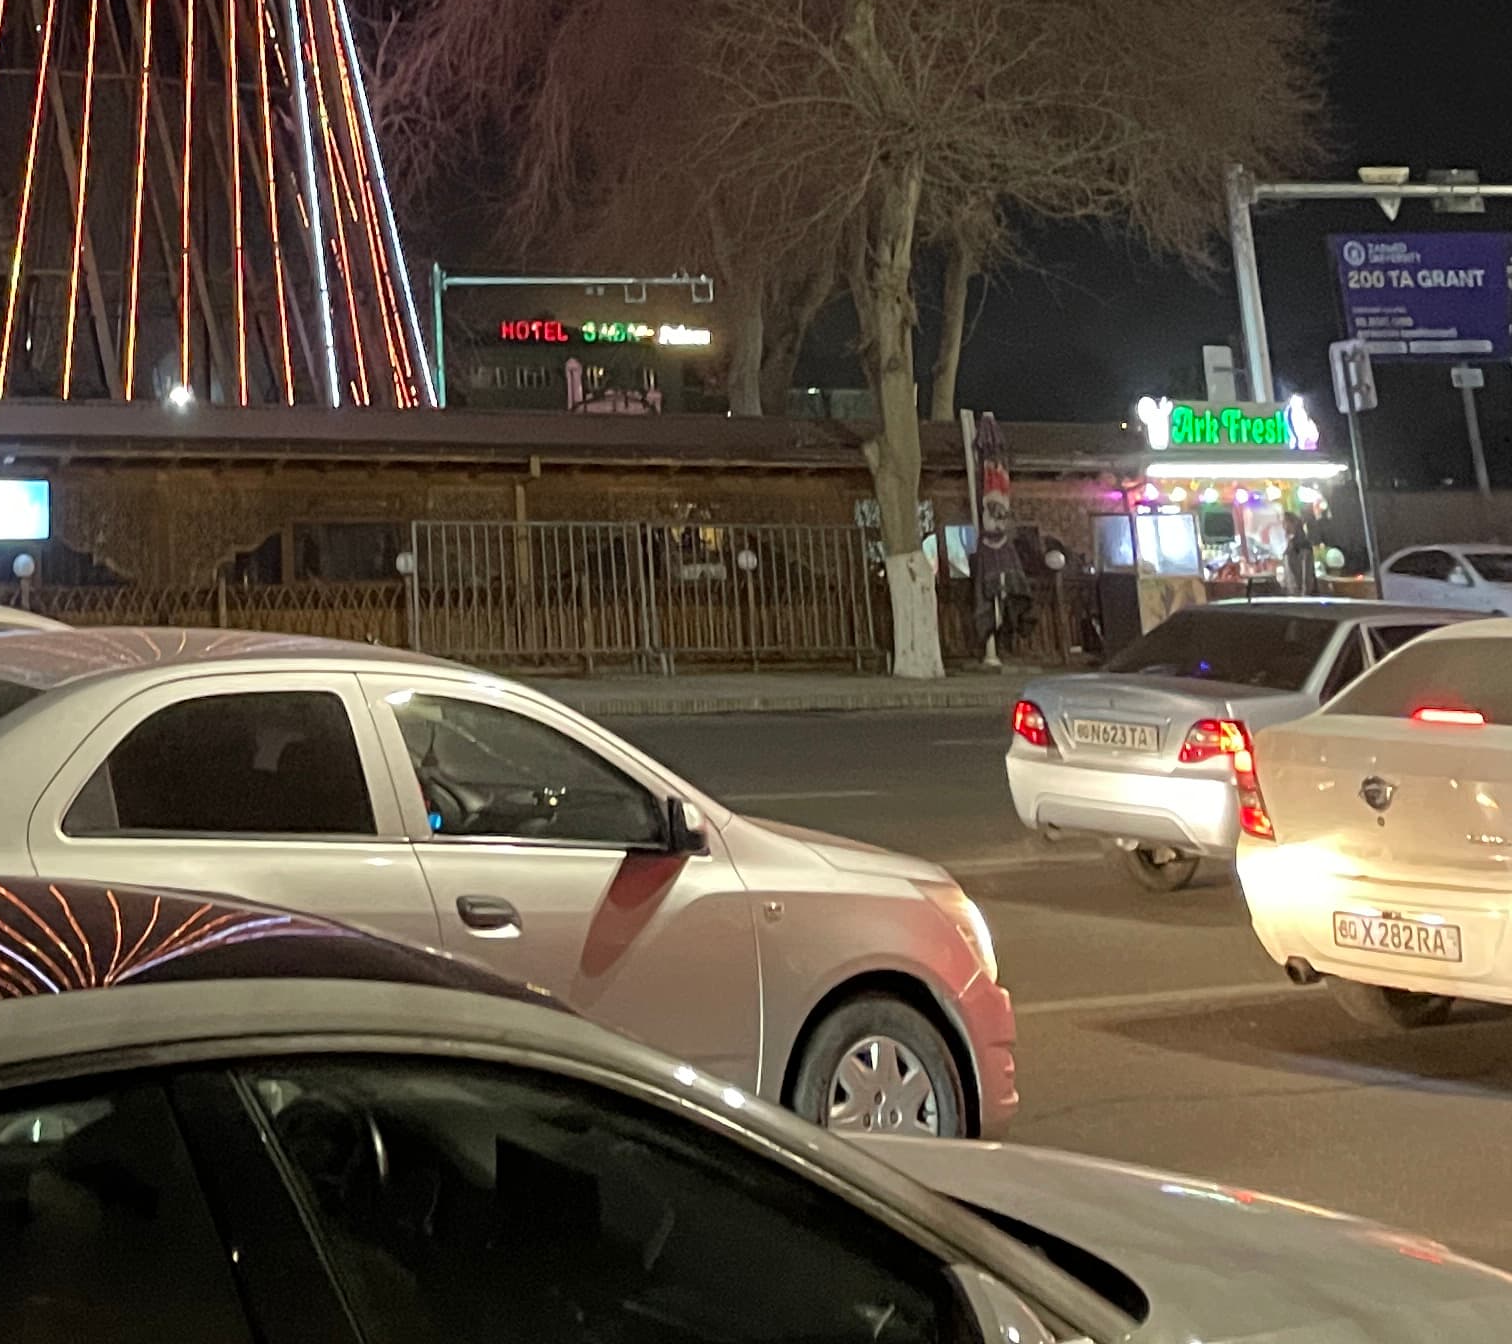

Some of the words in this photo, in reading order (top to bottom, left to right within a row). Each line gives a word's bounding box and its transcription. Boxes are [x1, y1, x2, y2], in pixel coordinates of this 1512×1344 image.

[1348, 270, 1385, 289] 200
[1388, 269, 1415, 288] TA
[1416, 268, 1485, 288] GRANT
[500, 320, 569, 342] HOTEL
[1171, 405, 1220, 444] Ark
[1220, 407, 1290, 445] Fresh
